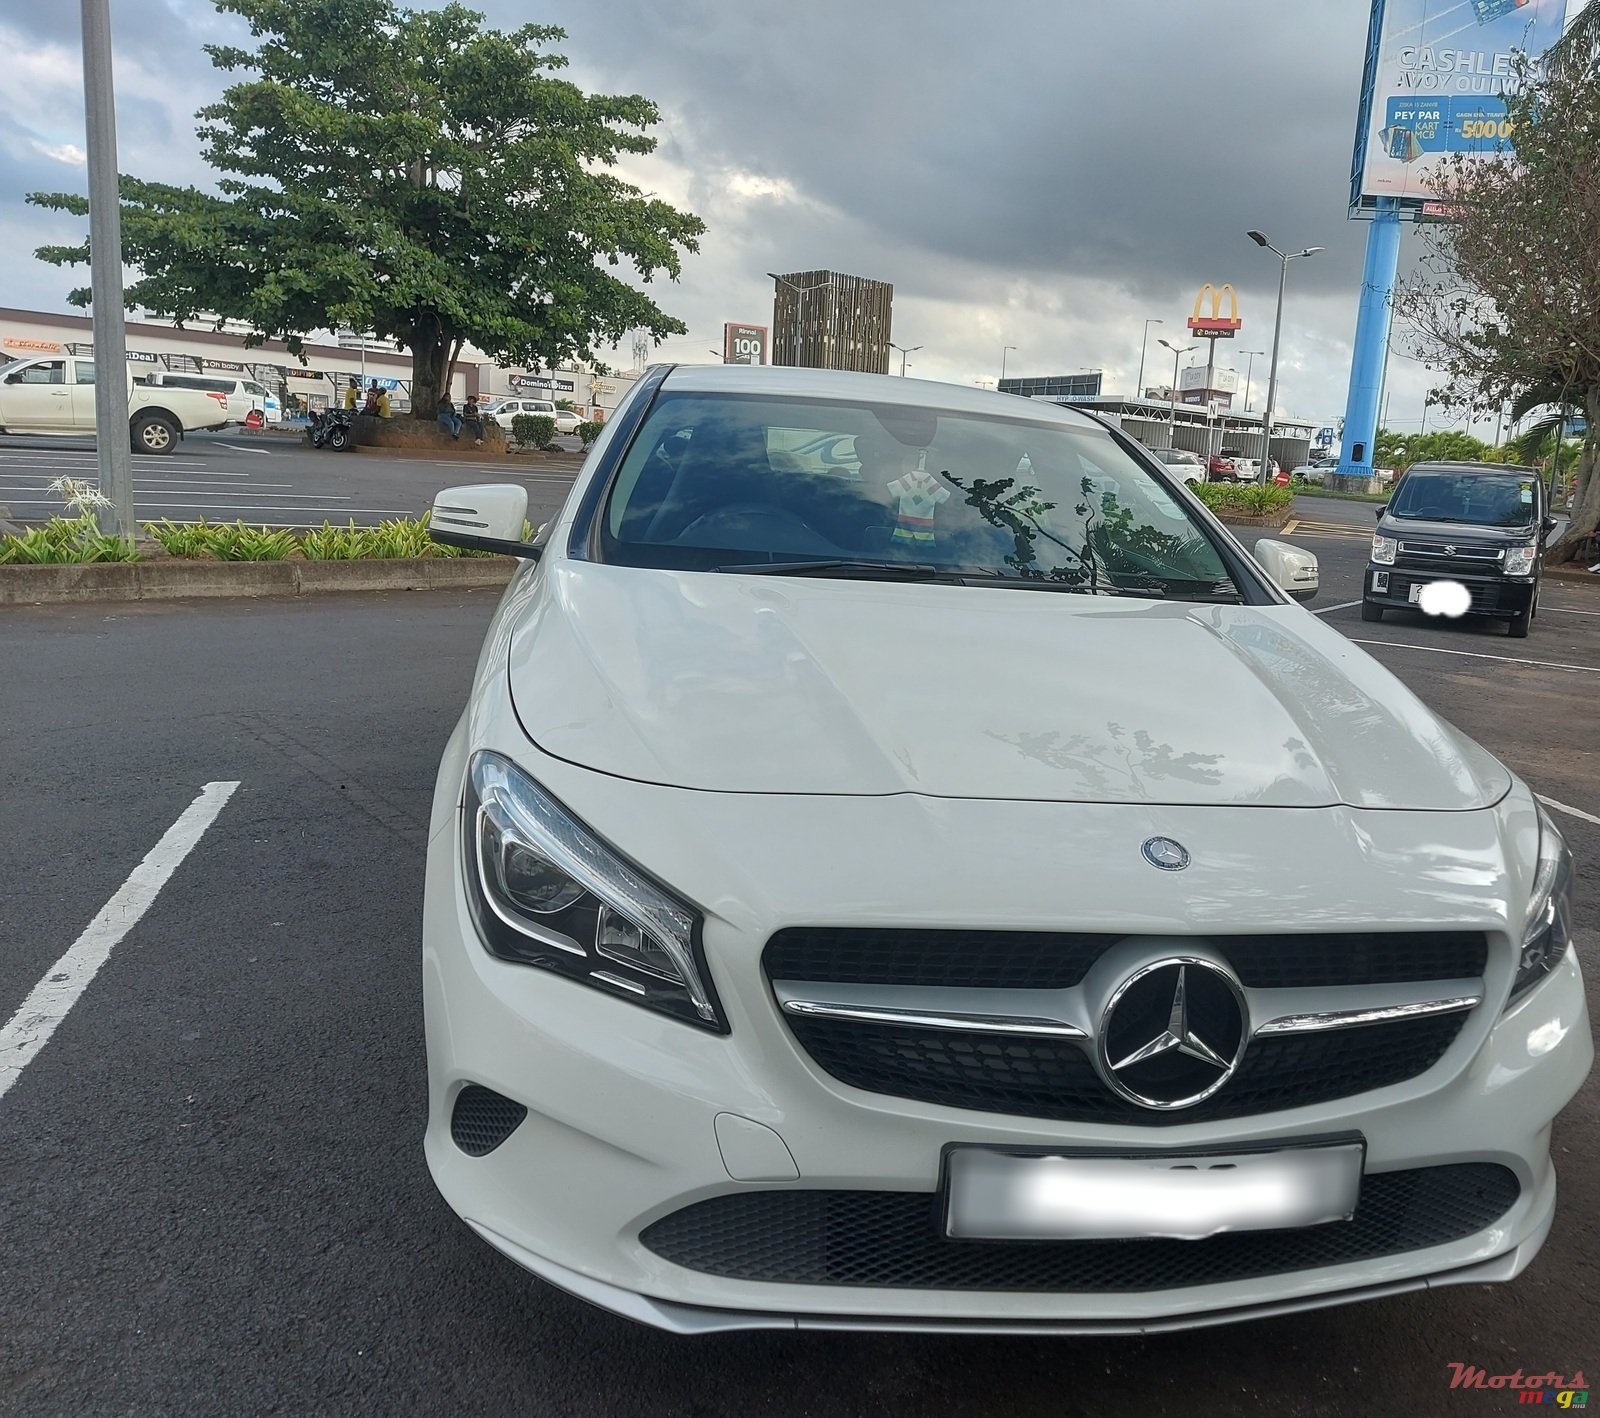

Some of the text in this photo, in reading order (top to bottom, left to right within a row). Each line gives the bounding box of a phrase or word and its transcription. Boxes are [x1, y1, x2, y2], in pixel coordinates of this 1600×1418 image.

[1394, 111, 1440, 120] PEY PAR
[1415, 122, 1440, 130] KART
[1415, 130, 1435, 139] MCB
[734, 338, 760, 354] 100
[221, 363, 240, 371] baby
[1210, 404, 1216, 416] N
